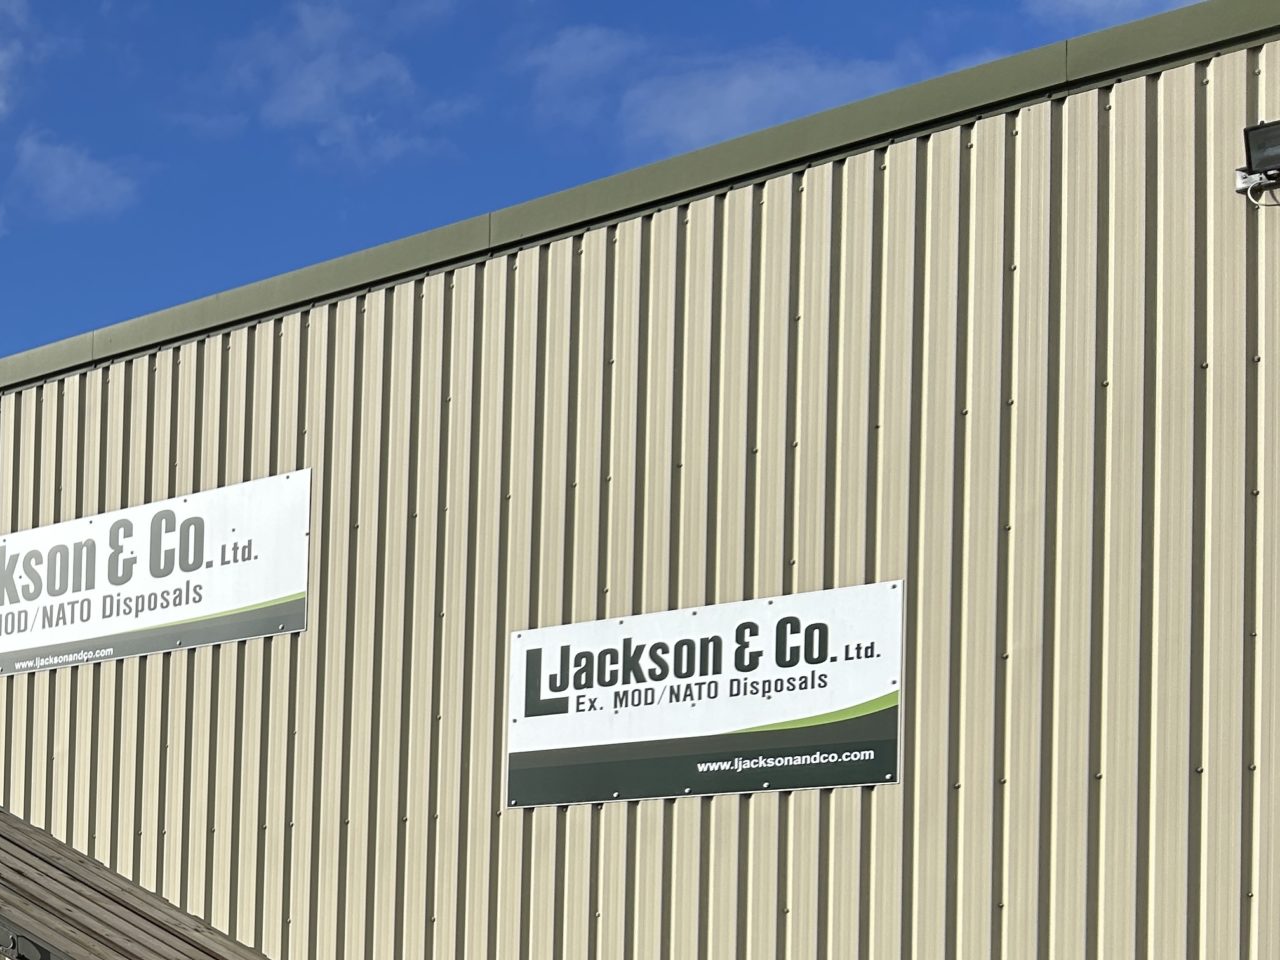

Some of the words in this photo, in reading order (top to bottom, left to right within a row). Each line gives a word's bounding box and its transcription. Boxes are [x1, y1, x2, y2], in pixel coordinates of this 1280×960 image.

[107, 518, 138, 586] &
[149, 508, 213, 580] Co.
[220, 539, 259, 566] Ltd.
[101, 580, 204, 619] Disposals
[15, 647, 114, 669] www.ljacksonandco.com
[734, 621, 764, 673] &
[775, 616, 838, 669] Co.
[844, 642, 881, 662] Ltd.
[575, 694, 604, 713] Ex.
[613, 679, 719, 709] MOD/NATO
[729, 670, 828, 698] Disposals
[696, 748, 875, 773] www.ljacksonandco.com
